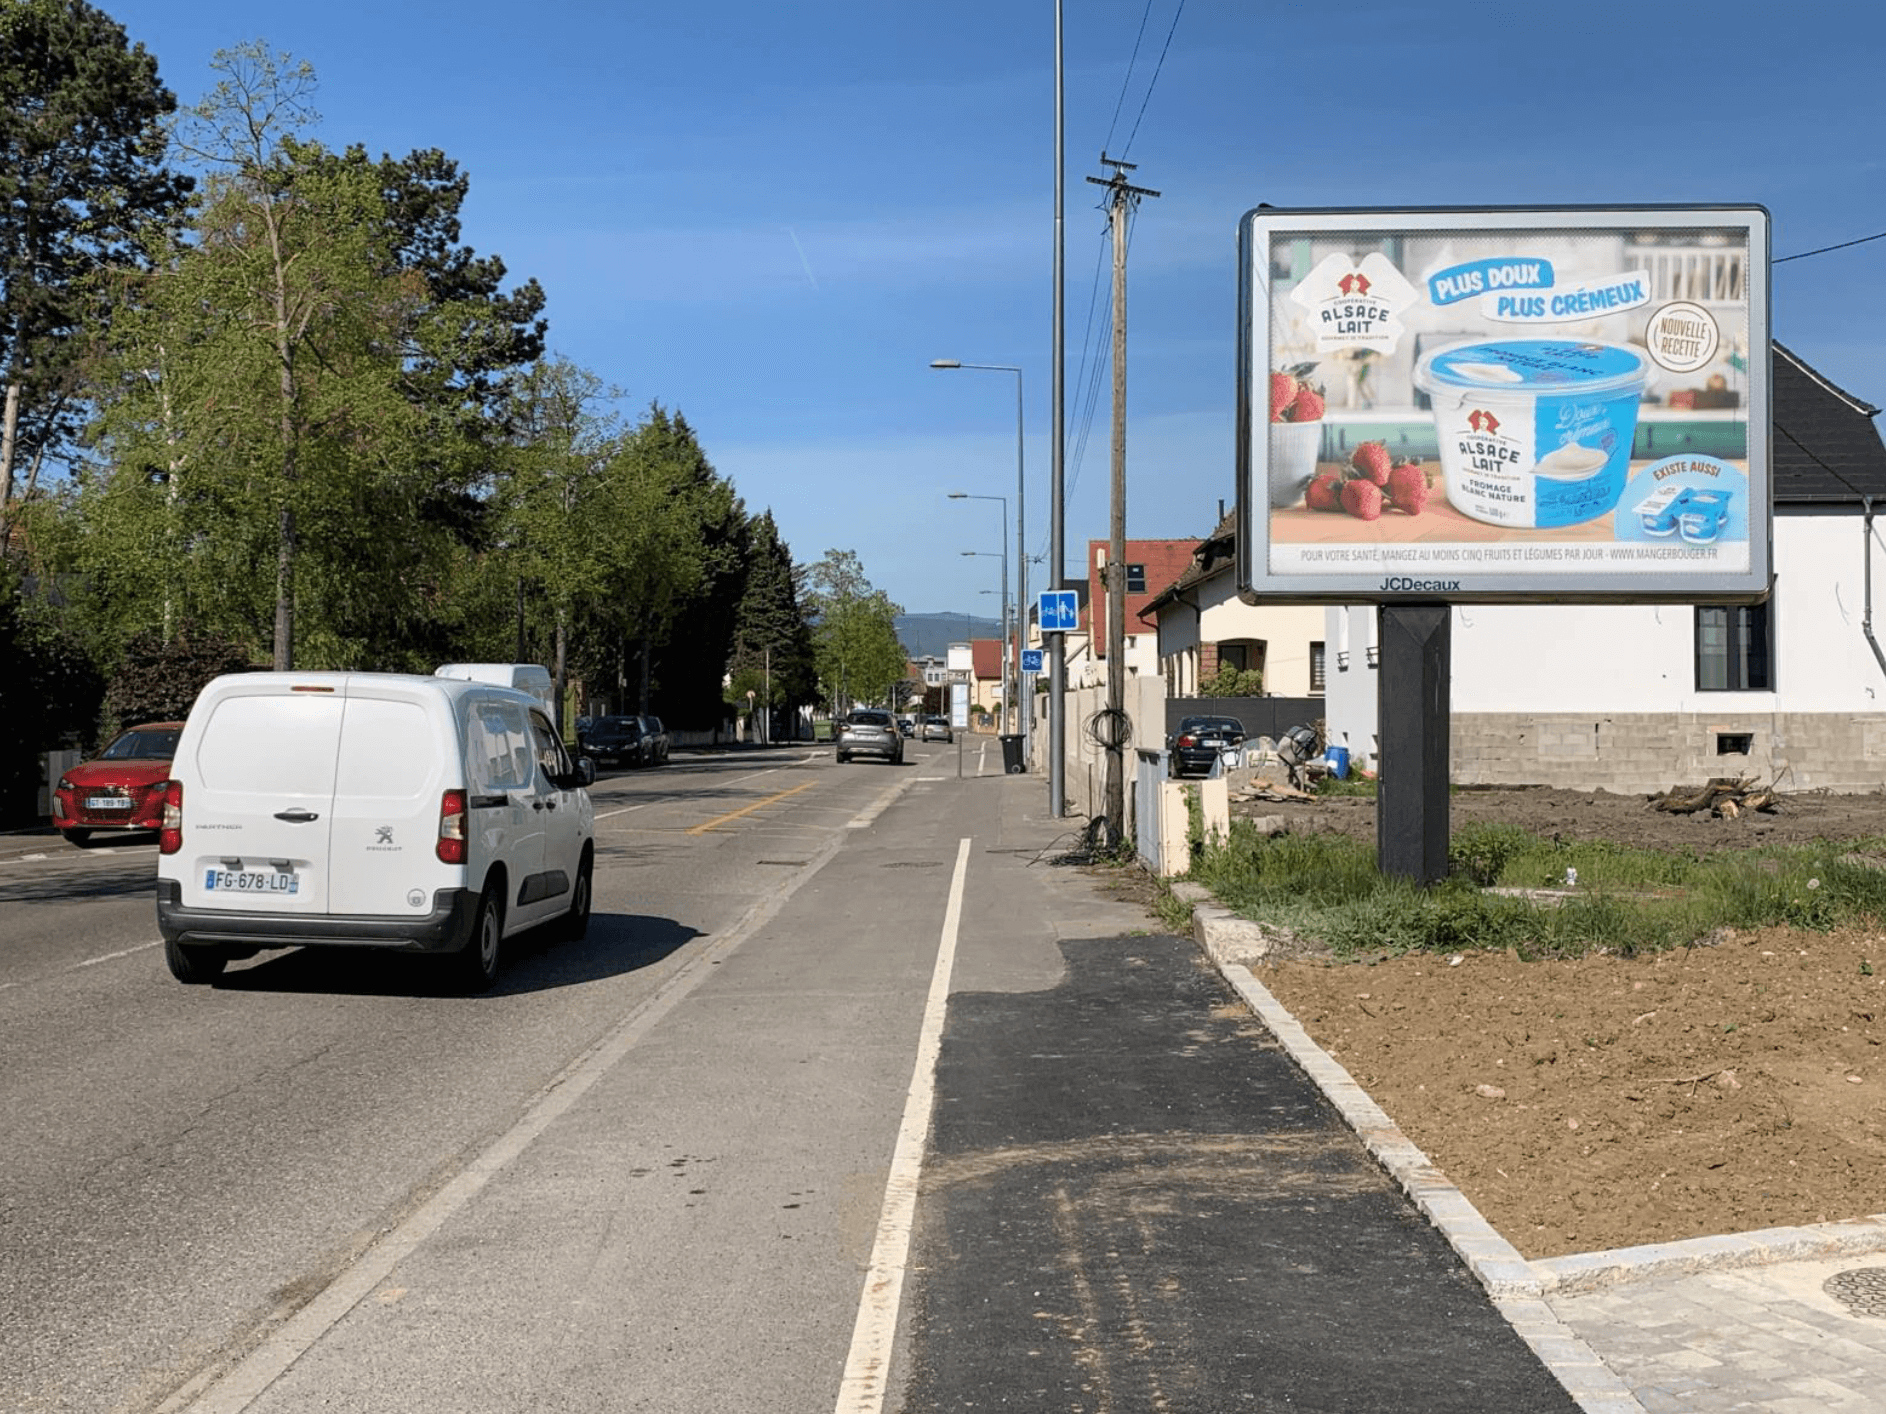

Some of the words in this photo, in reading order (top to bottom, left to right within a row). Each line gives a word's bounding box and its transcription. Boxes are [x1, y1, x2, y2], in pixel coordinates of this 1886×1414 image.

[1436, 270, 1483, 300] PLUS
[1488, 263, 1541, 288] DOUX
[1498, 296, 1546, 317] PLUS
[1551, 280, 1645, 316] CRÉMEUX
[1321, 305, 1390, 323] ALSACE
[1338, 321, 1372, 333] LAIT
[1660, 317, 1707, 339] NOUVELLE
[1661, 337, 1701, 358] RECETTE
[1459, 442, 1521, 464] ALSACE
[1472, 456, 1504, 473] LAIT
[1653, 461, 1687, 481] EXISTE
[1690, 461, 1722, 478] AUSSI
[1462, 484, 1486, 498] BLANC
[1488, 491, 1526, 503] NATURE
[1469, 479, 1512, 493] FROMAGE
[1301, 550, 1323, 562] POUR
[1325, 550, 1350, 561] VOTRE
[1382, 549, 1418, 561] MANGEZ
[1419, 549, 1431, 561] AU
[1432, 549, 1460, 561] MOINS
[1462, 549, 1483, 561] CINQ
[1484, 549, 1511, 561] FRUITS
[1513, 549, 1522, 561] ET
[1524, 547, 1562, 561] LÉGUMES
[1565, 549, 1581, 561] PAR
[1582, 549, 1603, 561] JOUR
[1610, 548, 1718, 561] WWW.MANGERBOUGER.FR
[1380, 577, 1460, 591] JCDecaux
[216, 872, 288, 890] FG-678-LD
